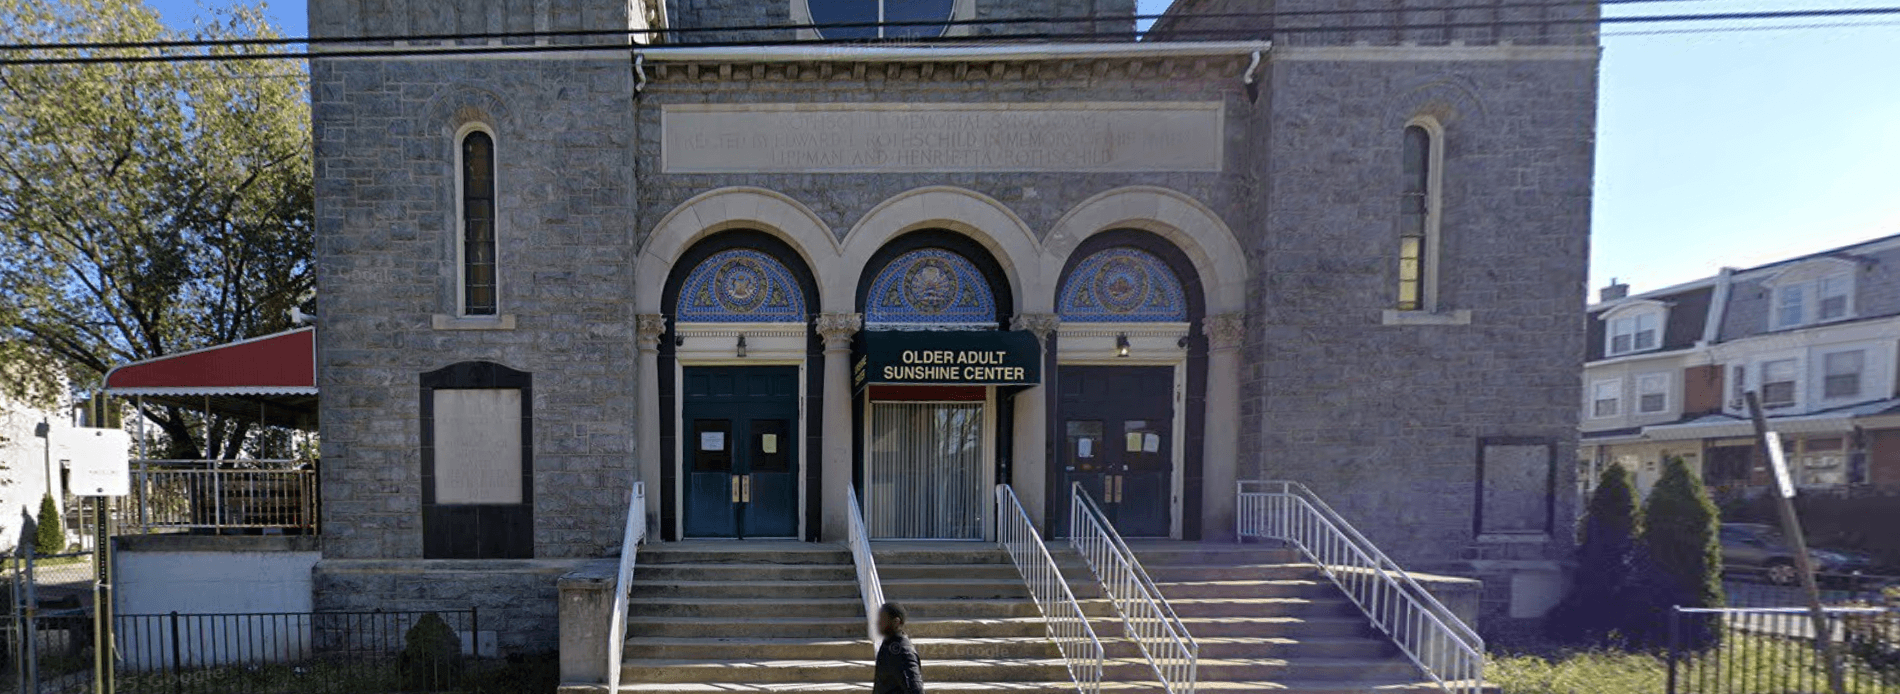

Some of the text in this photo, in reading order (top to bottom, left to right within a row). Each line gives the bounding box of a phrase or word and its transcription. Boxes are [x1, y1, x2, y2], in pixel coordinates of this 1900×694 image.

[896, 113, 983, 130] MEMORIAL
[774, 132, 841, 148] EDWARD
[866, 132, 977, 149] ROTHSCHILD
[983, 132, 1001, 148] IN
[1006, 131, 1074, 148] MEMORY
[771, 148, 1112, 166] LIPPMAN AND HENRIETTA ROTHSCHILD
[902, 350, 1006, 364] OLDER ADULT
[883, 365, 960, 380] SUNSHINE
[963, 366, 1025, 380] CENTER
